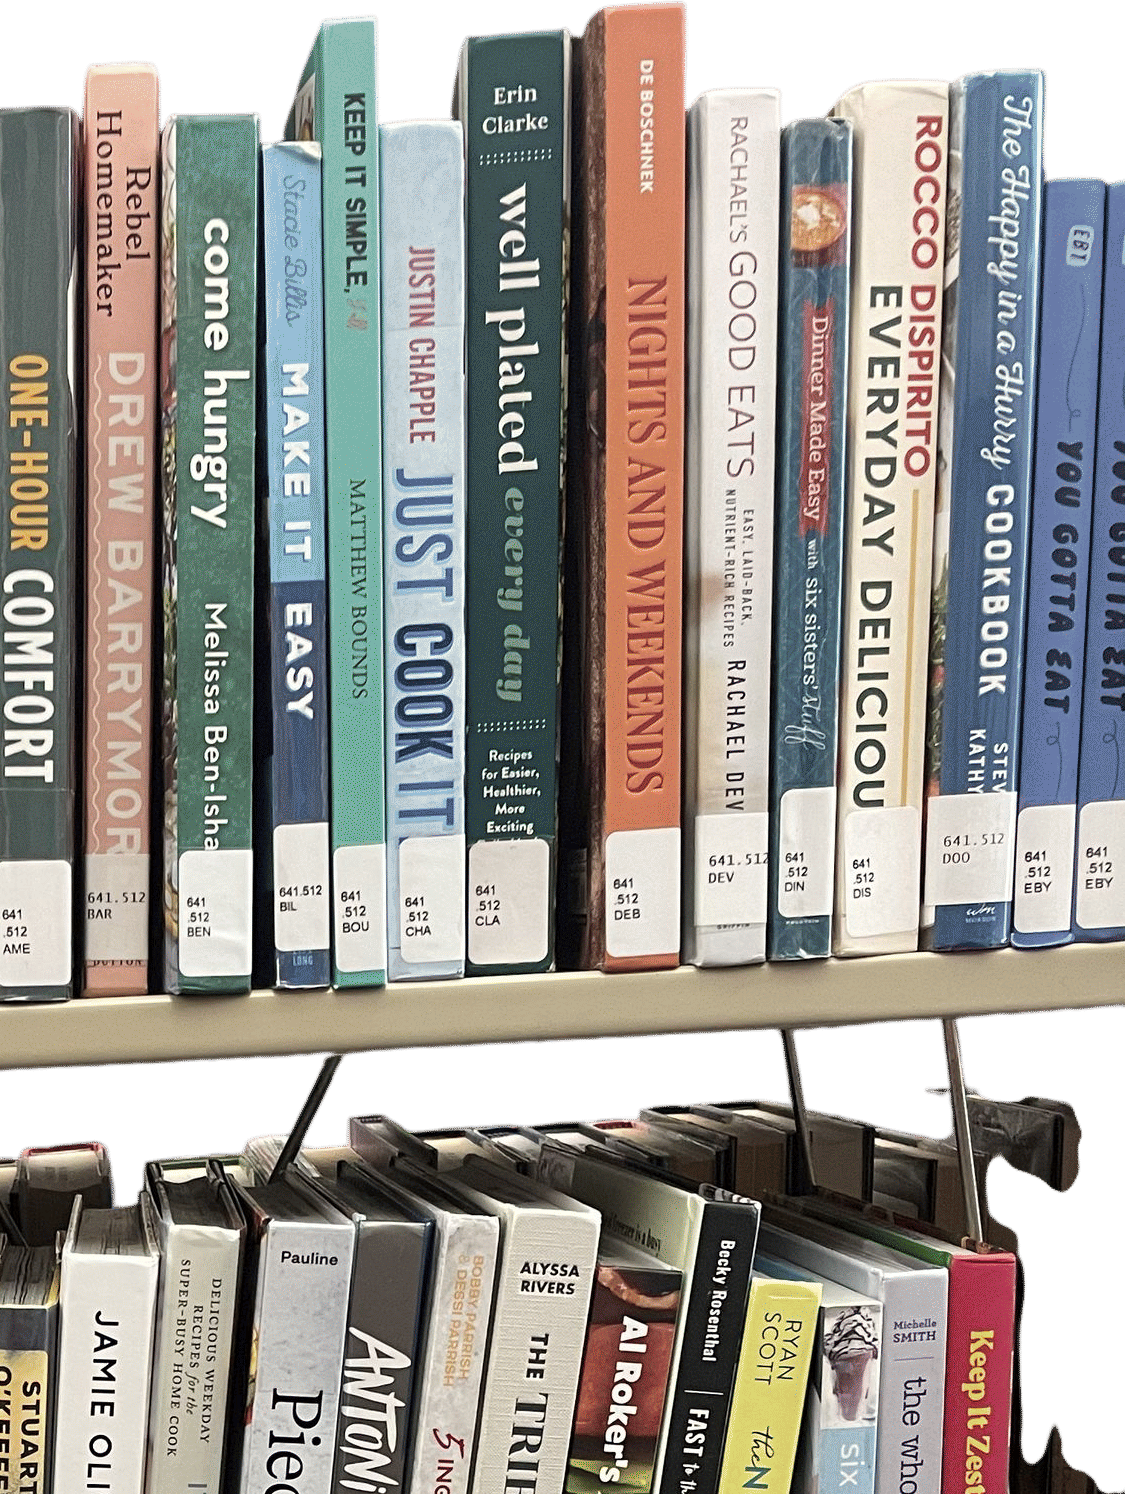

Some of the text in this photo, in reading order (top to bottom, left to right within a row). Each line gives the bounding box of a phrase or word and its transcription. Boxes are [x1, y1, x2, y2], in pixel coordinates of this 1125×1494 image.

[493, 87, 537, 105] Erin
[483, 115, 549, 135] Clarke
[97, 110, 123, 318] Homemaker
[126, 165, 151, 261] Rebel
[904, 115, 942, 477] ROCCO DISPIRITO
[409, 246, 436, 444] JUSTIN CHAPPLE
[485, 183, 541, 476] well plated
[191, 217, 250, 529] come hungry
[862, 285, 902, 557] EVERYDAY
[281, 362, 313, 721] MAKE IT EASY
[626, 276, 667, 794] NIGHTS AND WEEKENDS
[3, 354, 54, 782] ONE-HOUR COMFORT
[481, 767, 539, 780] for Easier,
[489, 749, 532, 763] Recipes
[484, 785, 541, 798] Healthier,
[495, 802, 525, 815] More
[486, 820, 534, 835] Exciting
[87, 891, 146, 903] 641.512
[87, 908, 112, 919] BAR
[281, 1251, 338, 1265] Pauline
[520, 1262, 579, 1278] ALYSSA
[520, 1279, 575, 1294] RIVERS
[893, 1319, 937, 1330] Michelle
[893, 1331, 936, 1343] SMITH
[90, 1310, 119, 1418] JAMIE
[754, 1312, 782, 1386] SCOTT
[776, 1319, 802, 1382] RYAN
[961, 1329, 994, 1403] Keep
[902, 1376, 926, 1426] the
[970, 1407, 991, 1428] It
